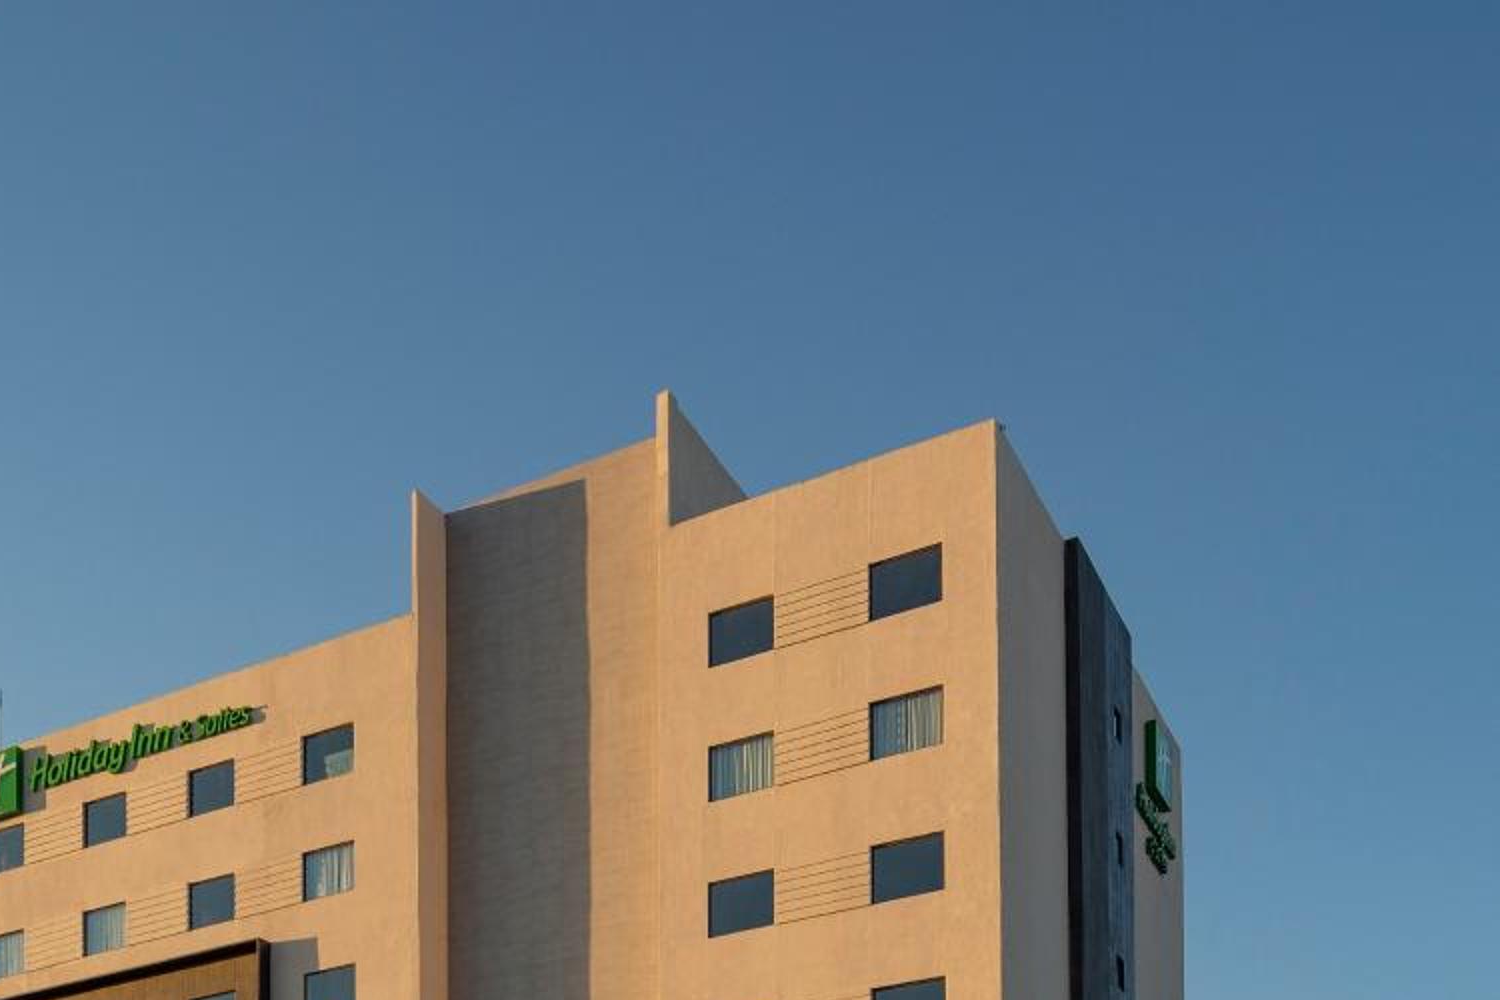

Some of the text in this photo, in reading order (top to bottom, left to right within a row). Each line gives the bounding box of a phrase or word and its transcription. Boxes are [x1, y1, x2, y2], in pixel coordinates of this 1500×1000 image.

[30, 739, 128, 792] Holiday
[130, 723, 171, 759] Inn
[180, 719, 192, 744] &
[196, 706, 253, 741] Suites
